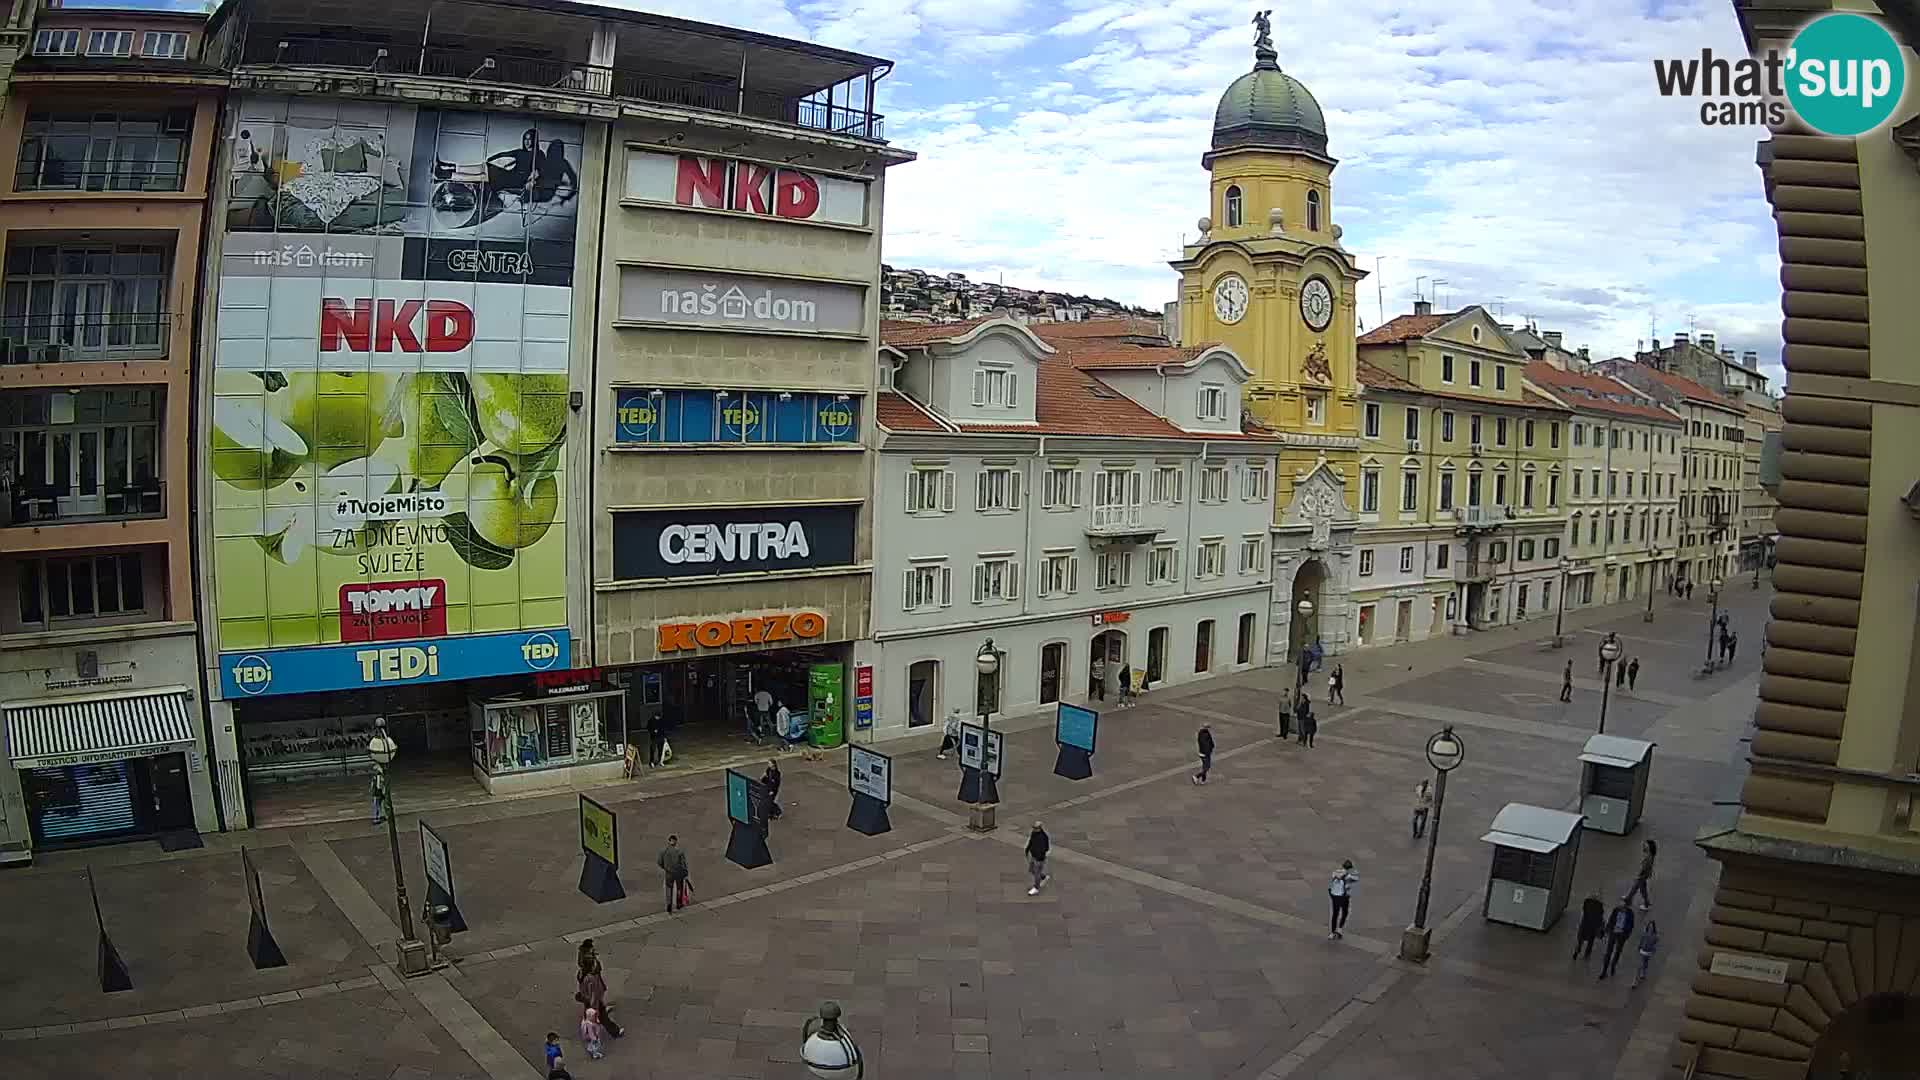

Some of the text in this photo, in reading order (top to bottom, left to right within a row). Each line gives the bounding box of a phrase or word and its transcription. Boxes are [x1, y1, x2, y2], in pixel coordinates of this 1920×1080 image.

[675, 157, 821, 219] NKD
[253, 246, 365, 267] naš dom
[447, 249, 534, 275] CENTRA
[661, 283, 816, 323] naš dom
[319, 297, 477, 353] NKD
[618, 407, 657, 425] TEDi
[723, 408, 760, 426] TEDi
[819, 409, 853, 426] TEDi
[336, 496, 445, 516] #TvojeMisto
[332, 523, 450, 549] ZA DNEVNO
[658, 520, 810, 564] CENTRA
[358, 546, 426, 575] SVJEŽE
[347, 586, 439, 615] TOMMY
[658, 612, 826, 653] KORZO
[356, 645, 440, 682] TEDi
[520, 642, 560, 661] TEDi
[232, 664, 273, 684] TEDi
